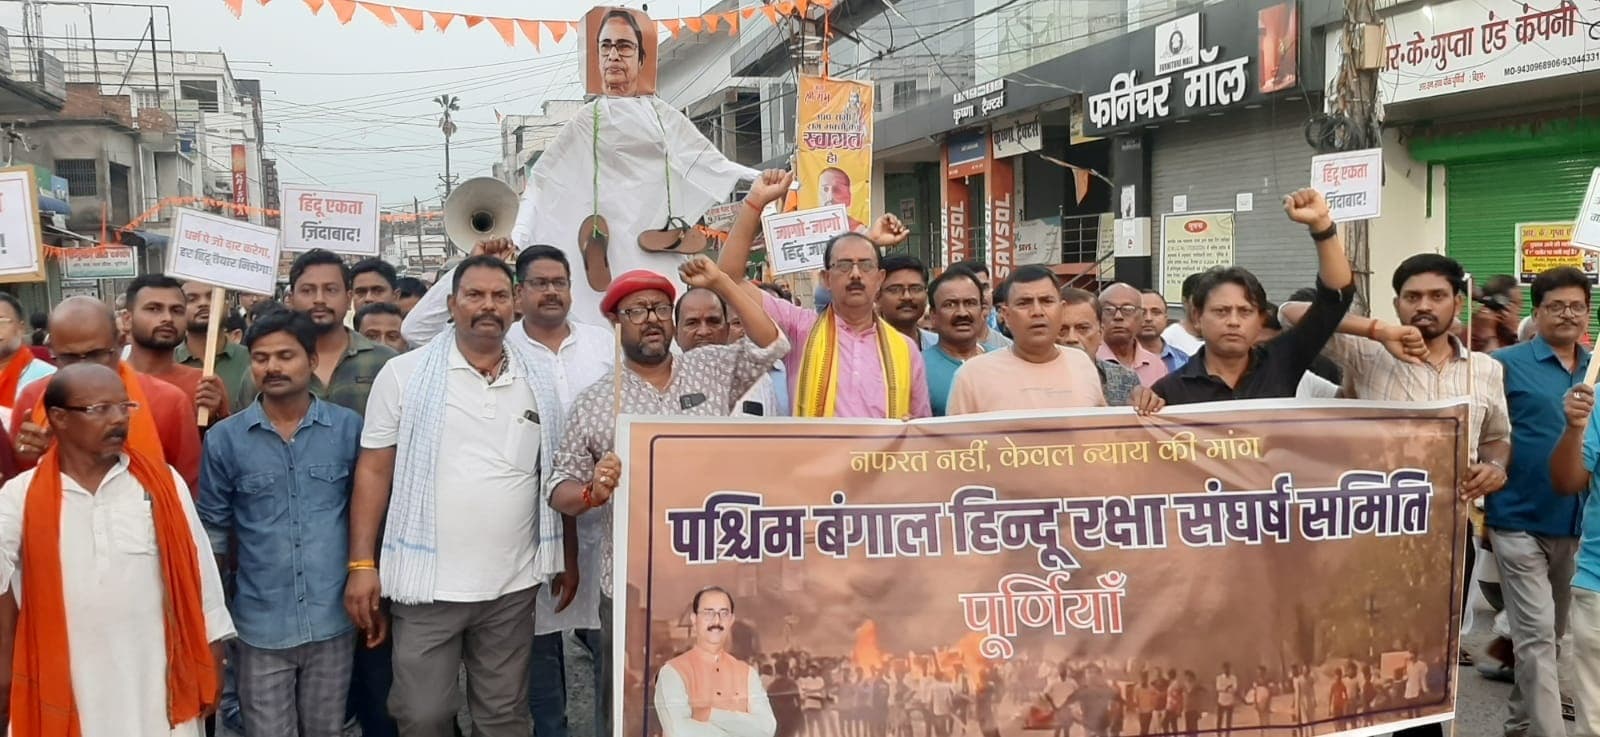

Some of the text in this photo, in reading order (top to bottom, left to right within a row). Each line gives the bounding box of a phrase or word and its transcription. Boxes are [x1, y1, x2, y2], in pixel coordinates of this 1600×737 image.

[1481, 11, 1509, 54] एंड
[1515, 1, 1578, 44] कंपनी
[1088, 45, 1248, 128] फर्निचर मॉल
[1159, 55, 1193, 72] FURNITURE MALL
[803, 131, 864, 150] स्वागत
[1341, 163, 1368, 180] एकता
[298, 192, 363, 217] हिंदू एकता
[781, 240, 809, 263] हिंदू
[951, 200, 964, 263] AVSOL
[995, 192, 1010, 279] SAVSOL
[850, 430, 1260, 472] नफरत नहीं, केवल न्याय की मांग
[666, 469, 1433, 570] पश्चिम बंगाल हिन्दू रक्षा संघर्ष समिति
[958, 570, 1127, 659] पूर्णियाँ
